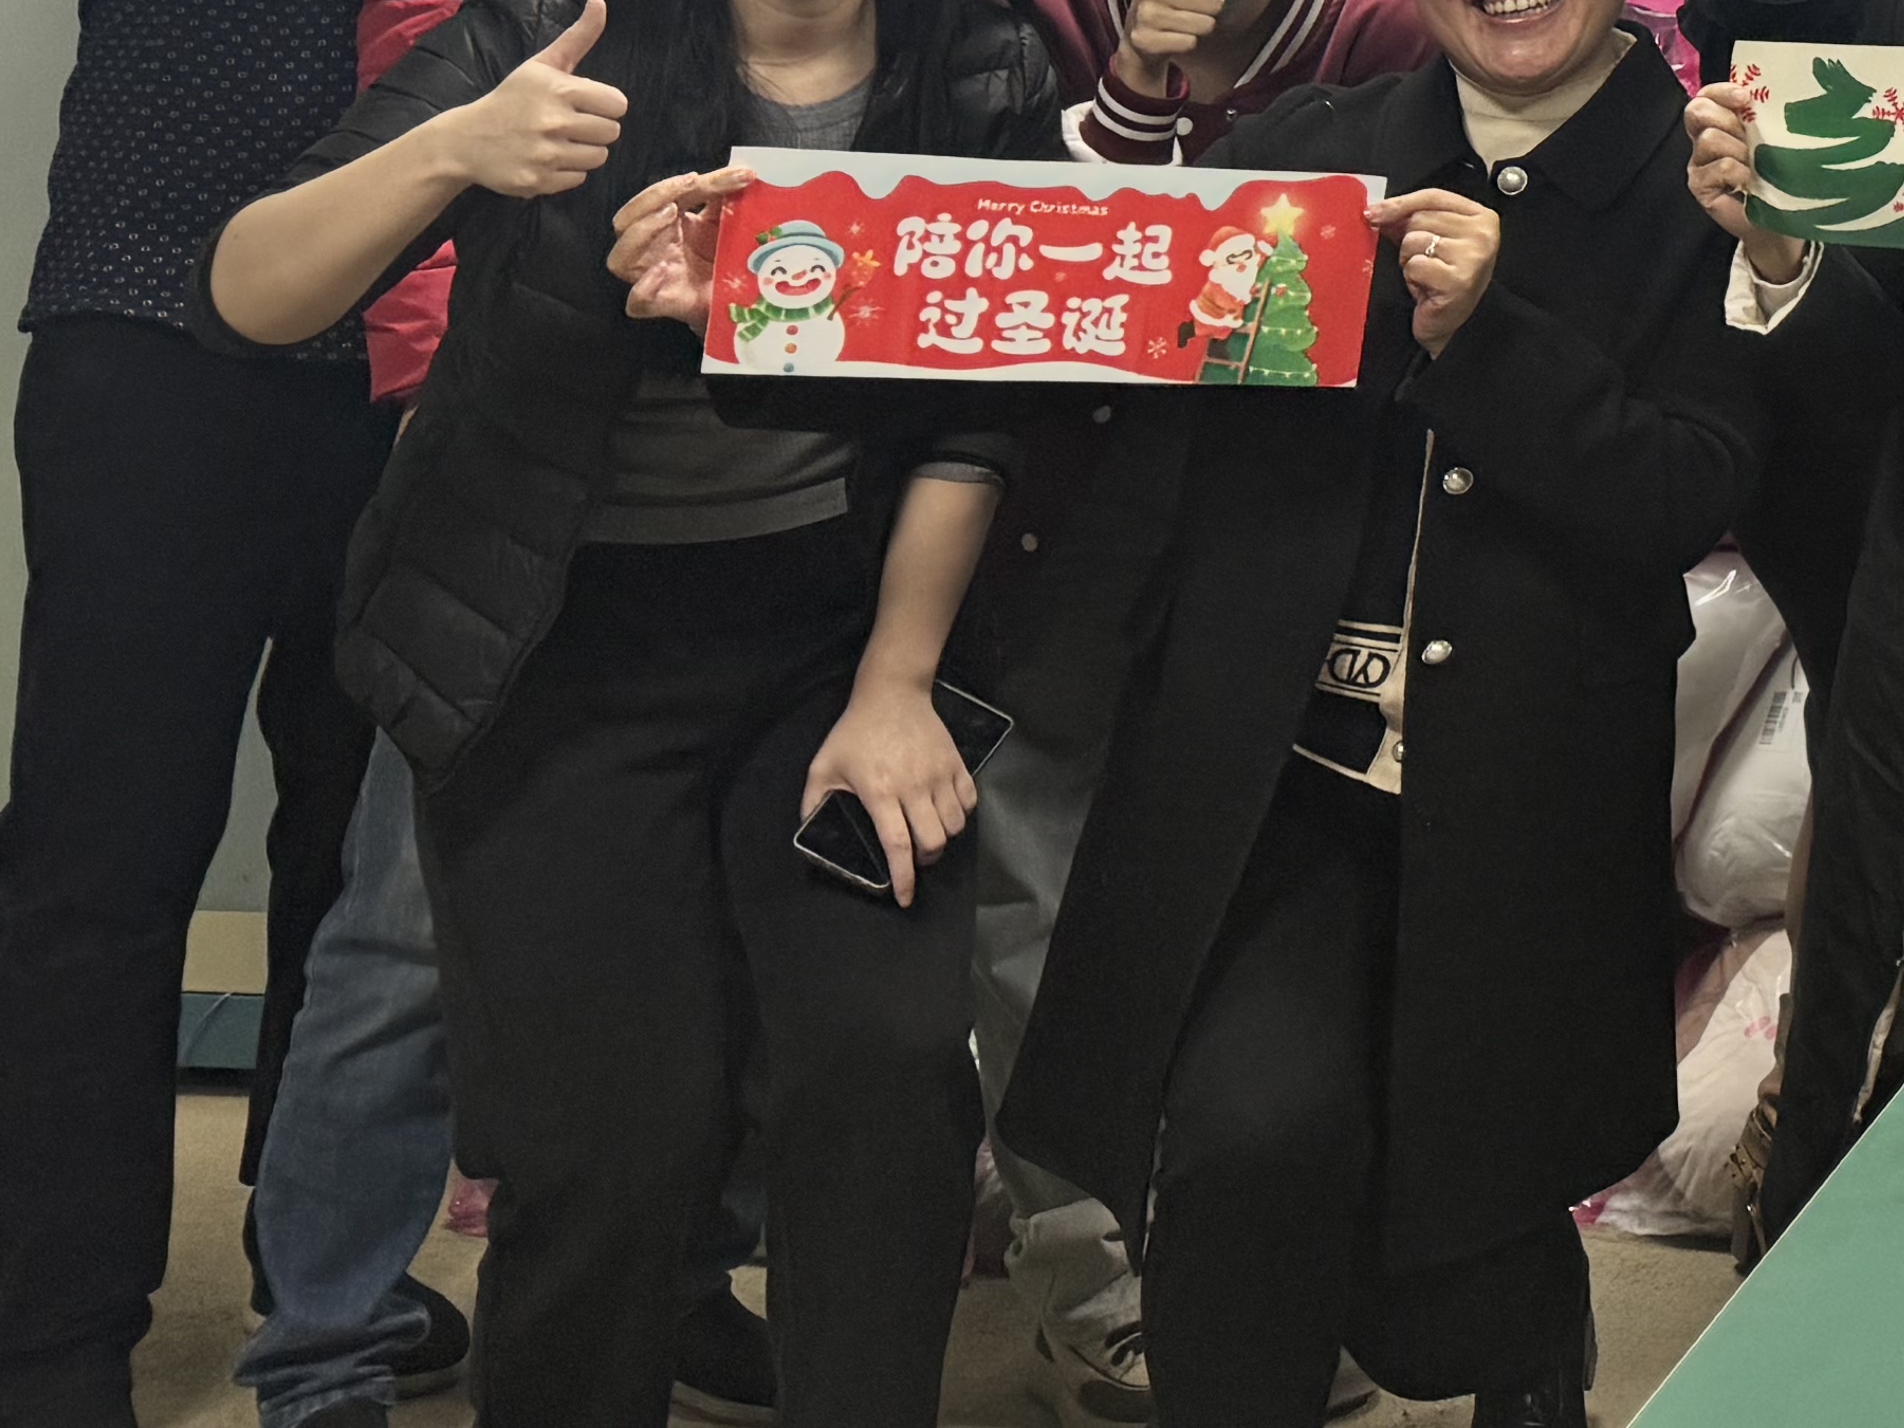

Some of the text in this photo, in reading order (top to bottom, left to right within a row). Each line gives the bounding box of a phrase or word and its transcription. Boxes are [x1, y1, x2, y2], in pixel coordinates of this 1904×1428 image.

[978, 199, 1108, 216] Merry Christmas
[893, 213, 1174, 287] 陪你一起
[919, 289, 1130, 355] 过圣诞
